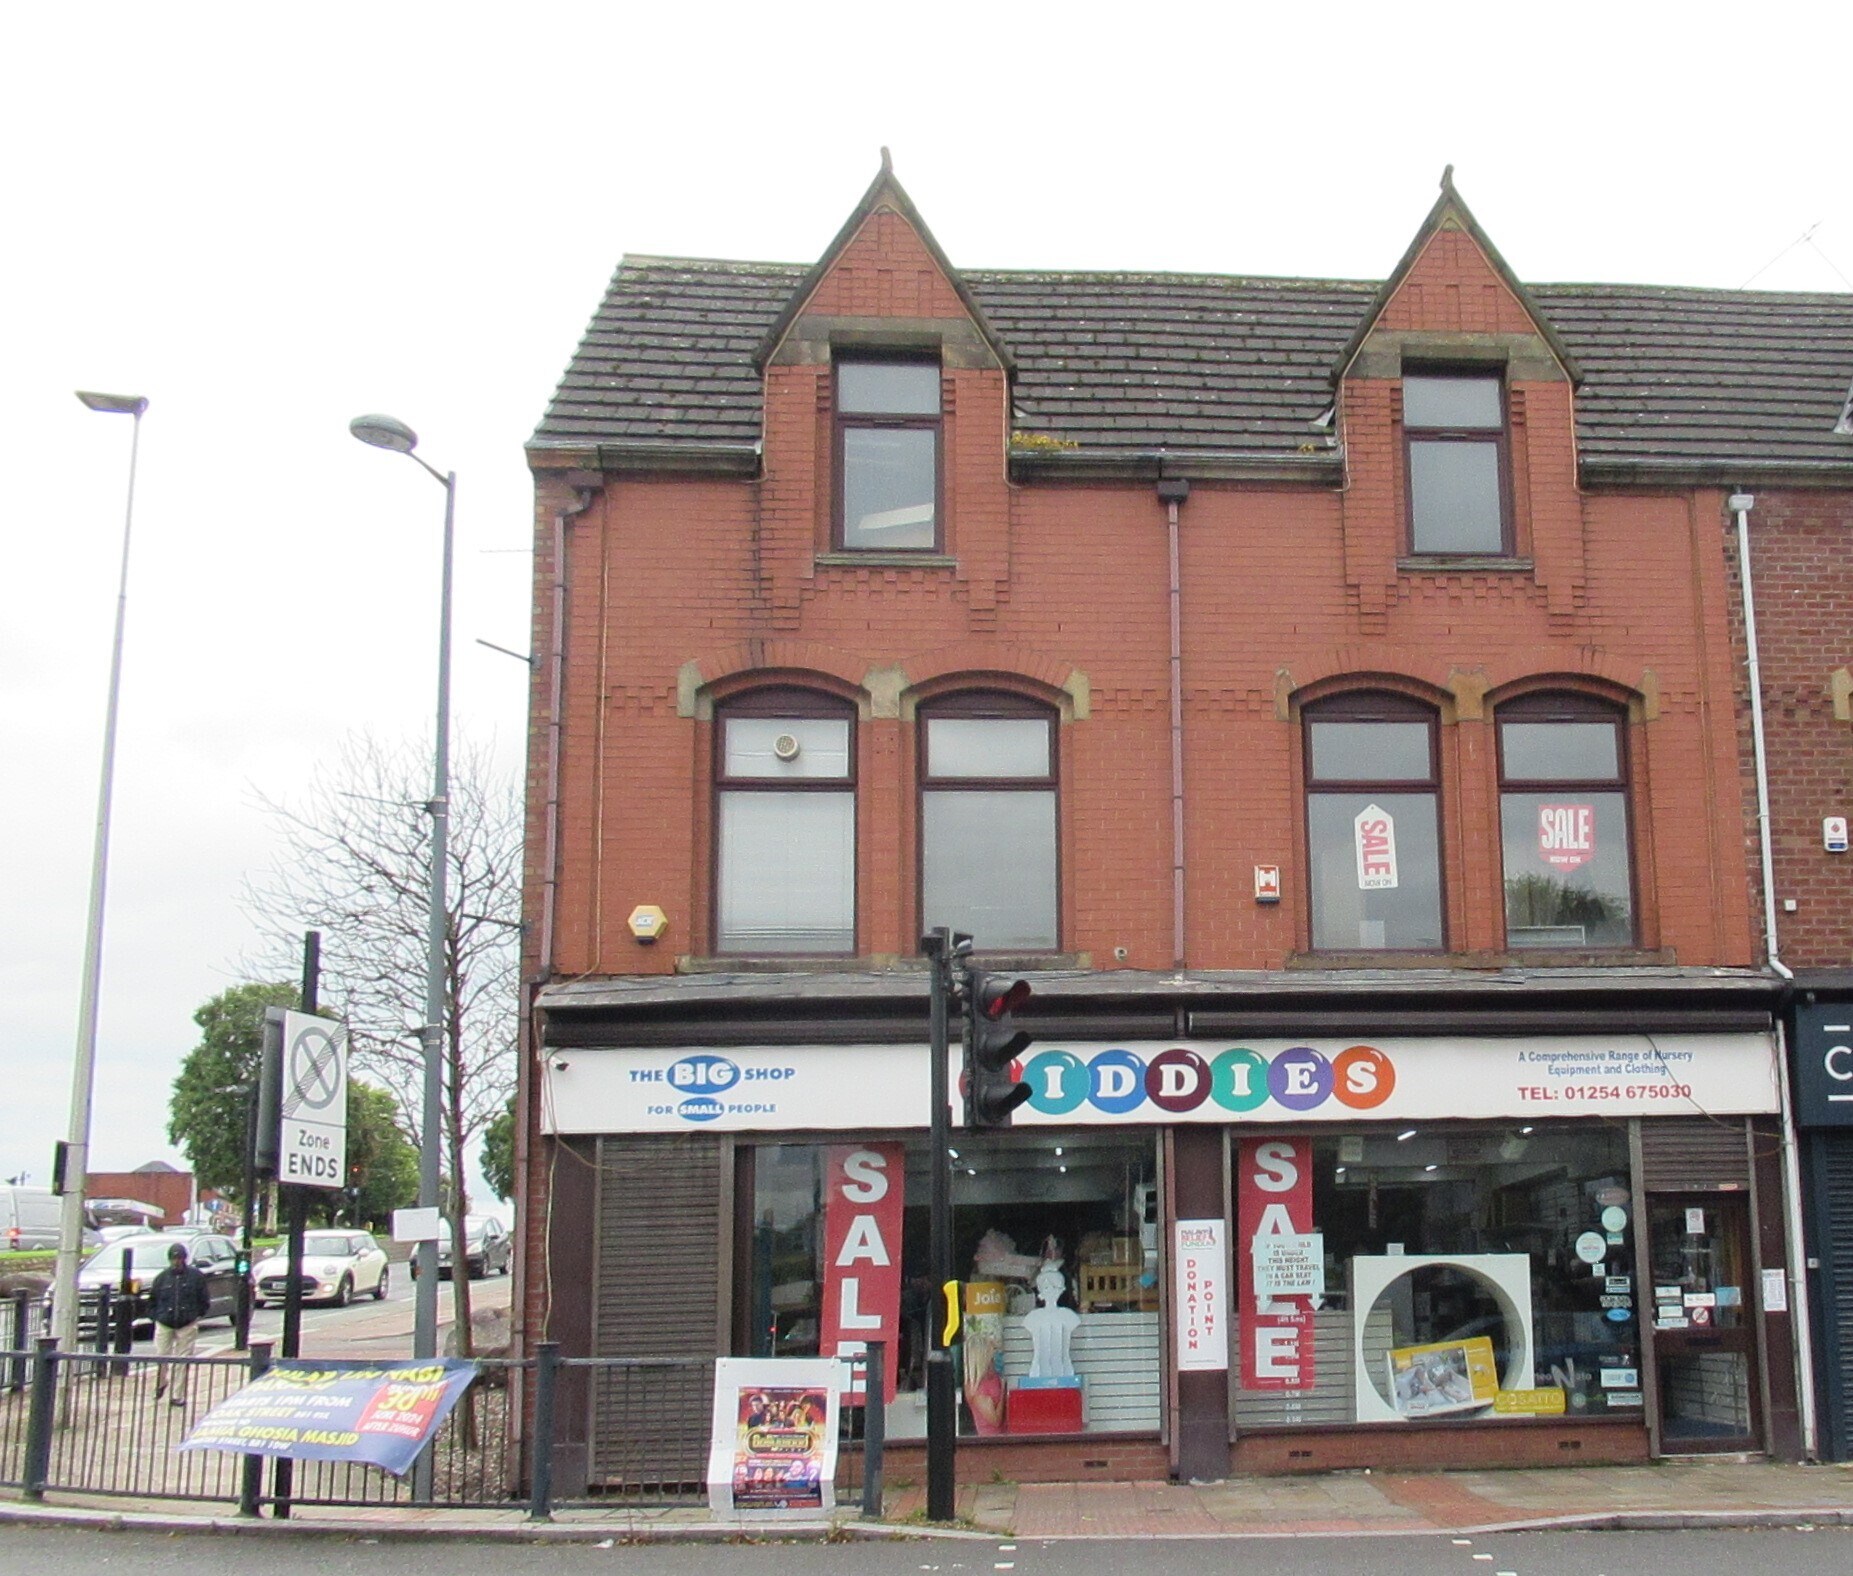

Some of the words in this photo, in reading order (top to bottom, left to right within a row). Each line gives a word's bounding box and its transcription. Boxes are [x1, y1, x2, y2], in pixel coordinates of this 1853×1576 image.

[1542, 809, 1590, 849] SALE
[1361, 820, 1391, 876] SALE
[1518, 1052, 1526, 1062] A
[1528, 1051, 1606, 1064] Comprehensive
[1609, 1051, 1639, 1063] Range
[1642, 1050, 1652, 1061] of
[1654, 1049, 1693, 1062] Nursery
[629, 1069, 664, 1082] THE
[673, 1062, 734, 1086] BIG
[744, 1067, 796, 1081] SHOP
[1044, 1060, 1378, 1100] IDDIES
[1547, 1064, 1601, 1076] Equipment
[1604, 1064, 1622, 1074] and
[1625, 1063, 1667, 1076] Clothing
[1517, 1086, 1559, 1101] TEL:
[1564, 1085, 1621, 1100] 01254
[1625, 1084, 1692, 1099] 675030
[647, 1105, 674, 1115] FOR
[679, 1103, 723, 1115] SMALL
[728, 1103, 777, 1114] PEOPLE
[299, 1129, 330, 1150] Zone
[288, 1153, 338, 1179] ENDS
[1186, 1259, 1198, 1349] DONATION
[1204, 1280, 1214, 1336] POINT
[307, 1395, 354, 1408] FROM
[238, 1425, 298, 1443] GHOSIA
[300, 1429, 361, 1446] MASJID
